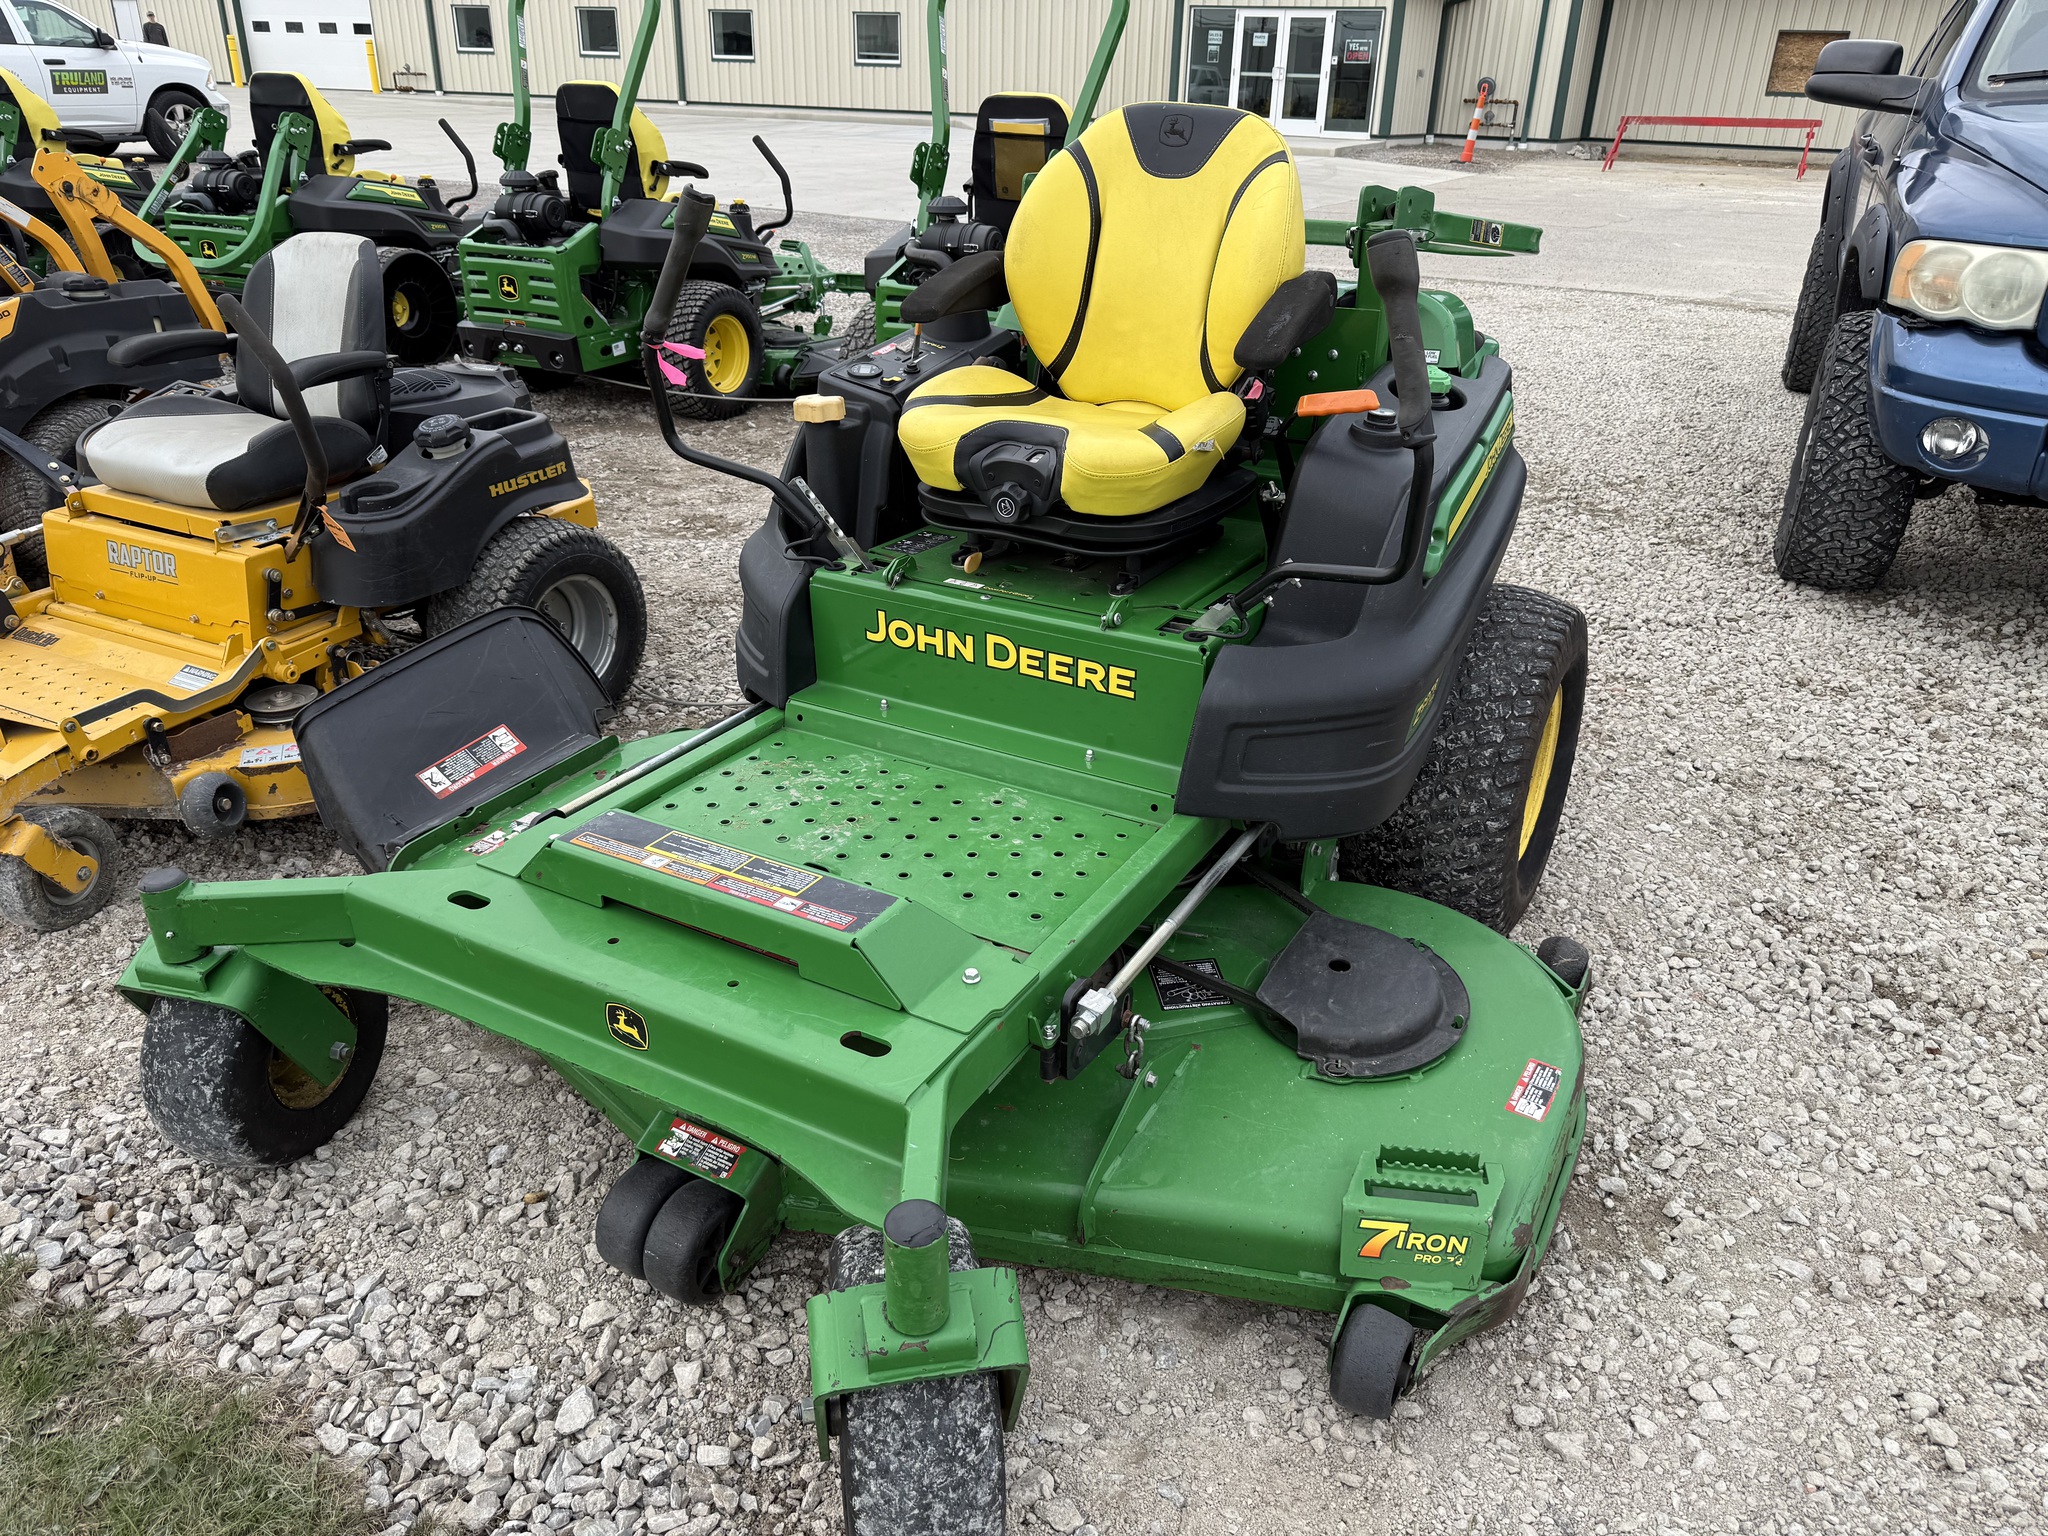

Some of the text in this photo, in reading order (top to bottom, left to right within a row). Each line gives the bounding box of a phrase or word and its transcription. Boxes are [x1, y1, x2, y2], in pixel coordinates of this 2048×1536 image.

[1349, 43, 1359, 51] YES
[1347, 51, 1369, 61] OPEN
[52, 71, 105, 86] TRULAND
[488, 461, 568, 498] HUSTLER
[106, 539, 178, 579] RAPTOR
[129, 571, 157, 582] FLIP-UP
[865, 608, 1137, 700] JOHN DEERE
[189, 666, 217, 681] WARNING
[686, 1125, 741, 1153] DANGER PELIGRO
[1414, 1254, 1442, 1264] PRO
